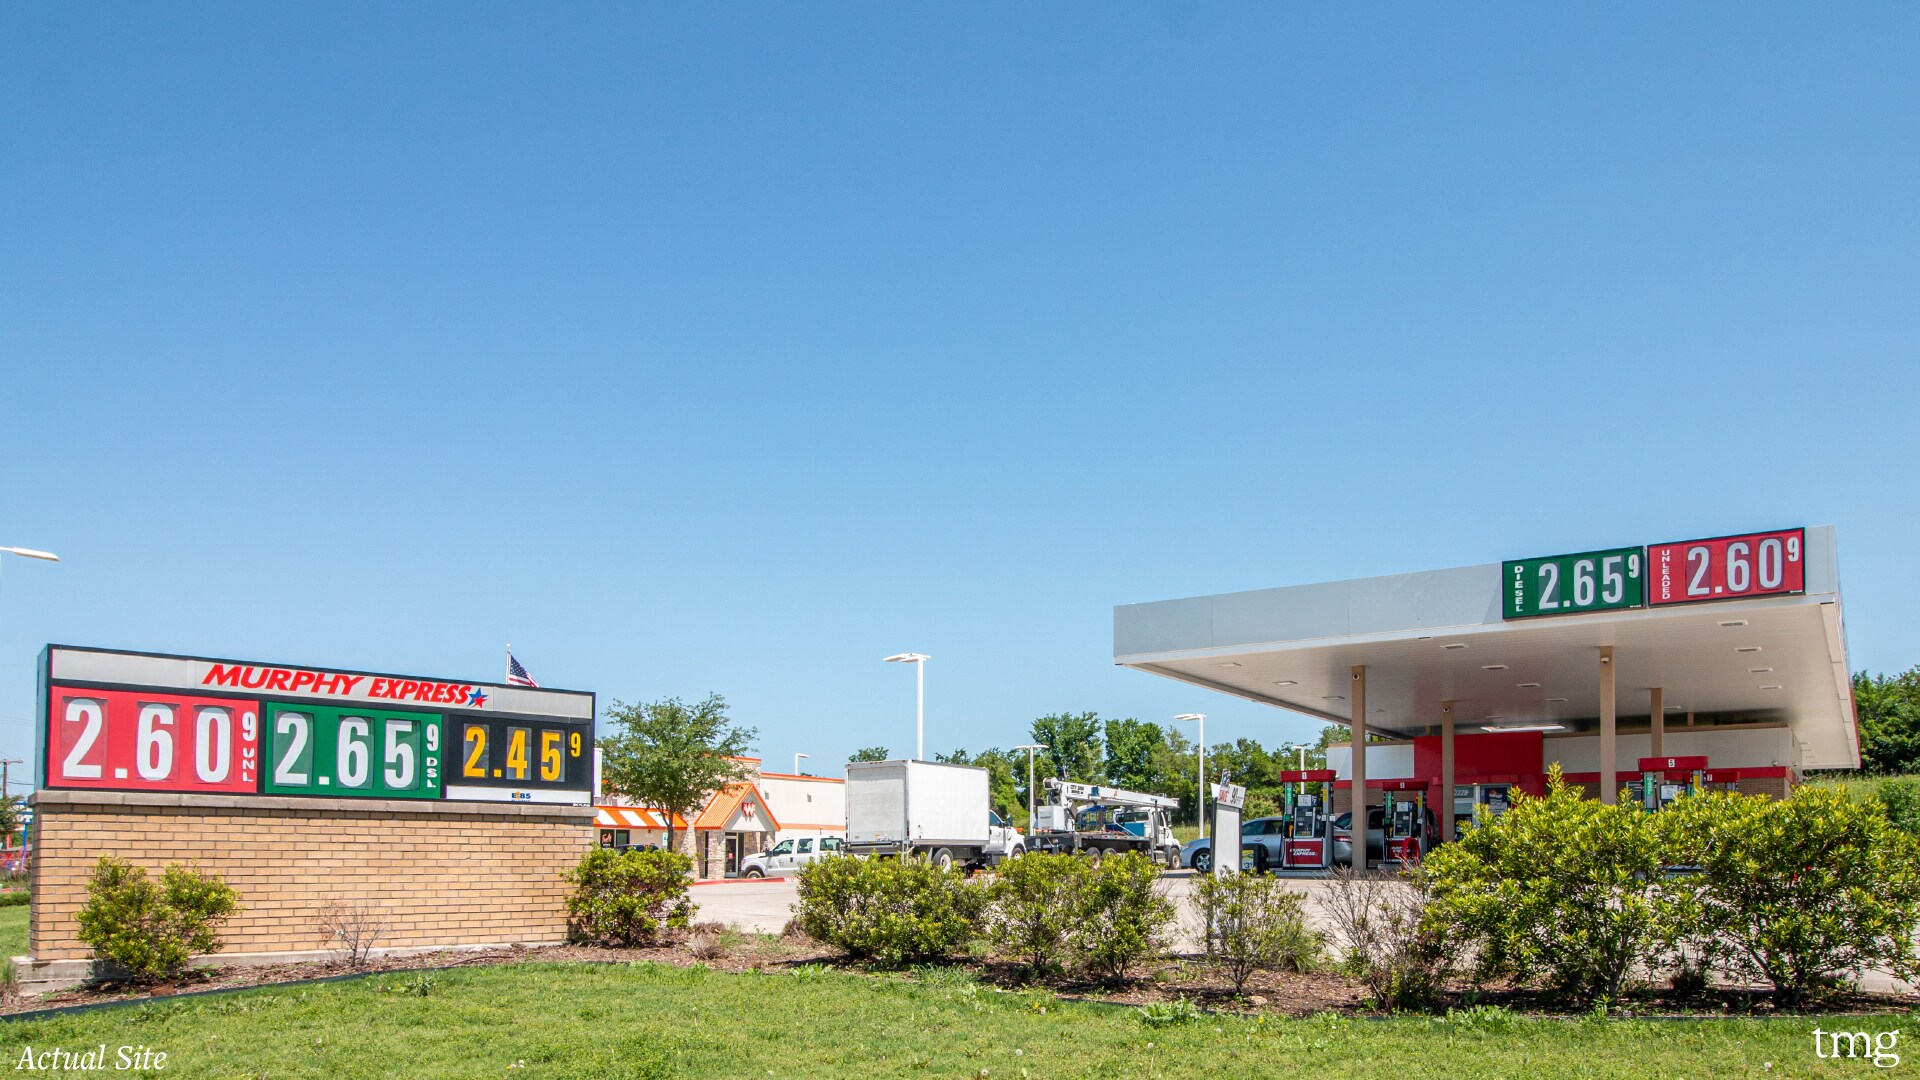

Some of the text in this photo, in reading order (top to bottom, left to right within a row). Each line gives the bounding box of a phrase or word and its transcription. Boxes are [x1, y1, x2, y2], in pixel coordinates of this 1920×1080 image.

[1514, 565, 1524, 612] DIESEL
[1661, 549, 1671, 600] UNLEADED
[202, 664, 472, 704] MURPHY EXPRESS
[242, 747, 255, 782] UNL
[426, 757, 438, 788] DSL
